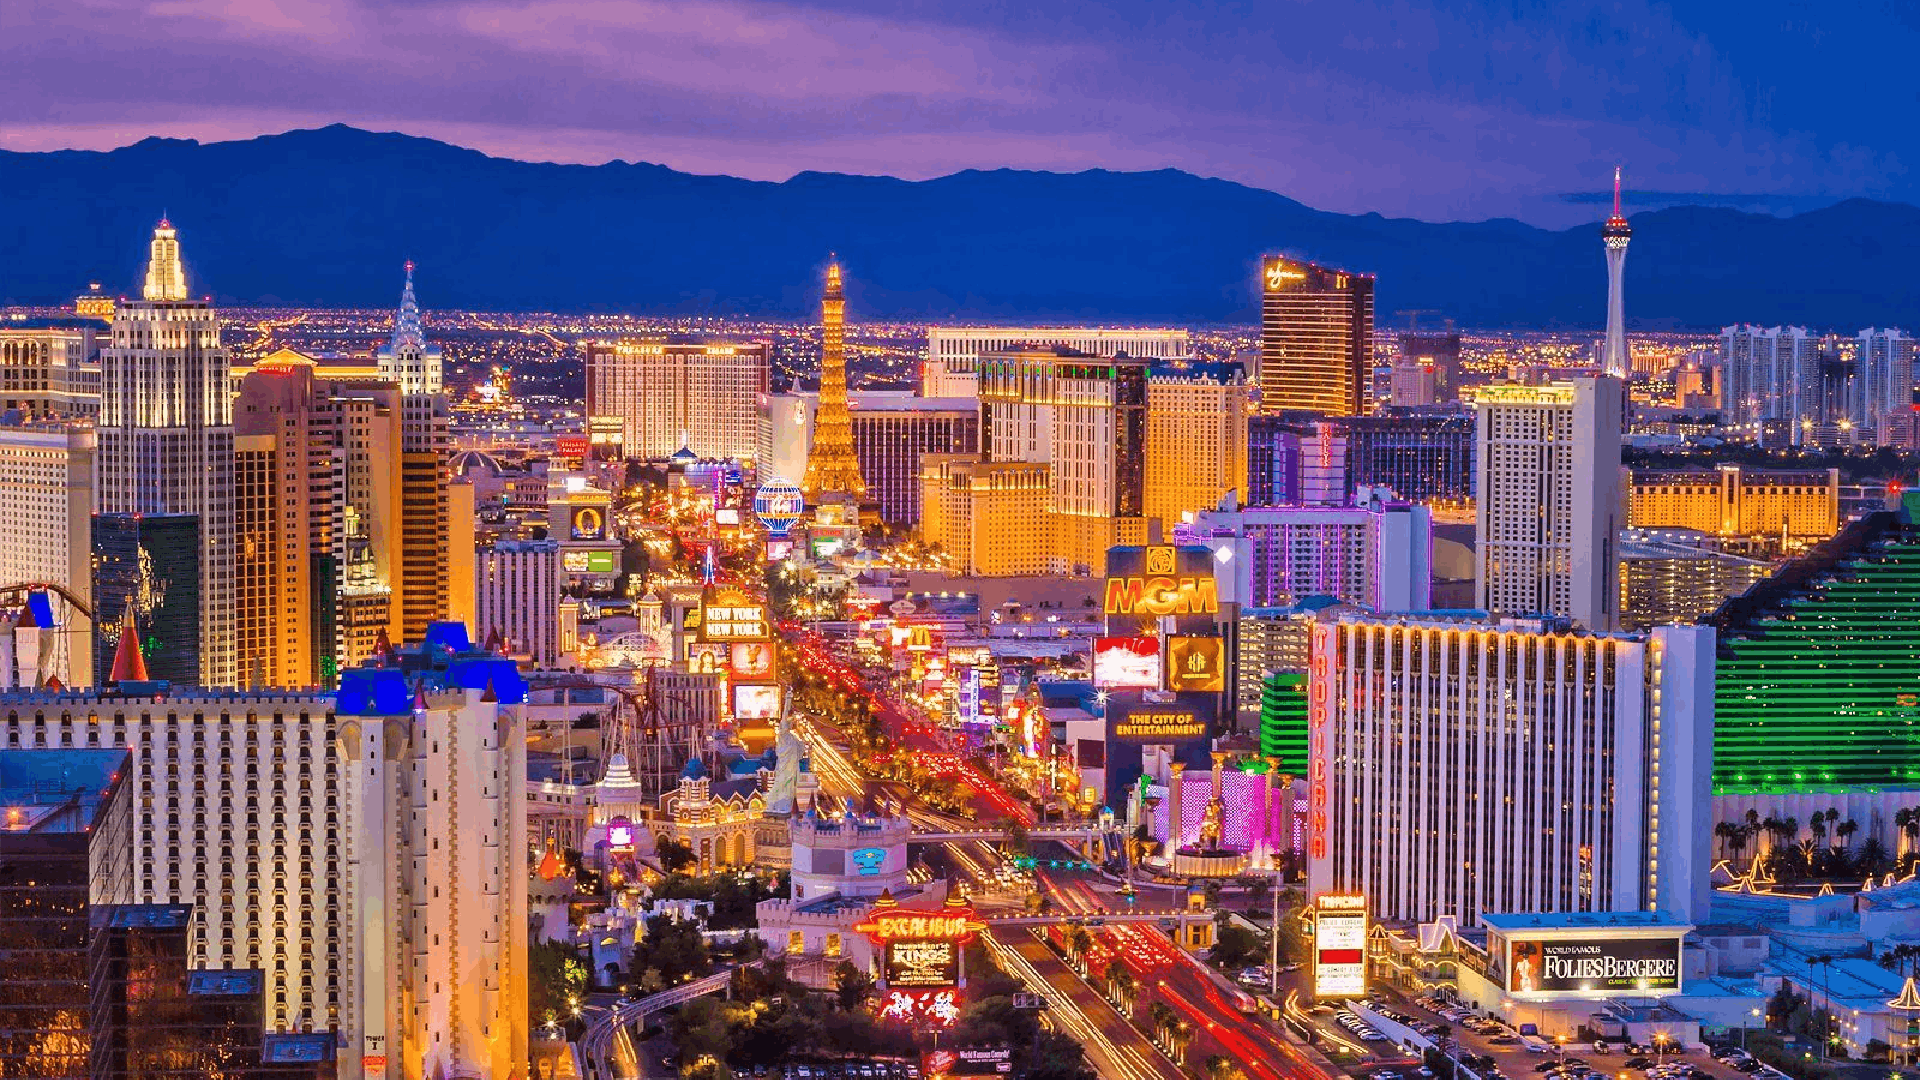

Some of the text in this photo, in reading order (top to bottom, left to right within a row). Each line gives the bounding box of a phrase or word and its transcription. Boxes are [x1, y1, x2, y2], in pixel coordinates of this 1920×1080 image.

[1104, 576, 1219, 615] MGM
[706, 607, 762, 620] NEW YORK
[706, 624, 762, 636] NEW YORK
[1129, 714, 1193, 724] THE CITY OF
[1116, 724, 1206, 735] ENTERTAINMENT
[1314, 628, 1327, 860] TROPICANA
[878, 917, 967, 937] EXCALIBUR
[1571, 945, 1602, 954] FAMOUS
[892, 949, 950, 963] KINGS
[959, 1050, 973, 1059] World
